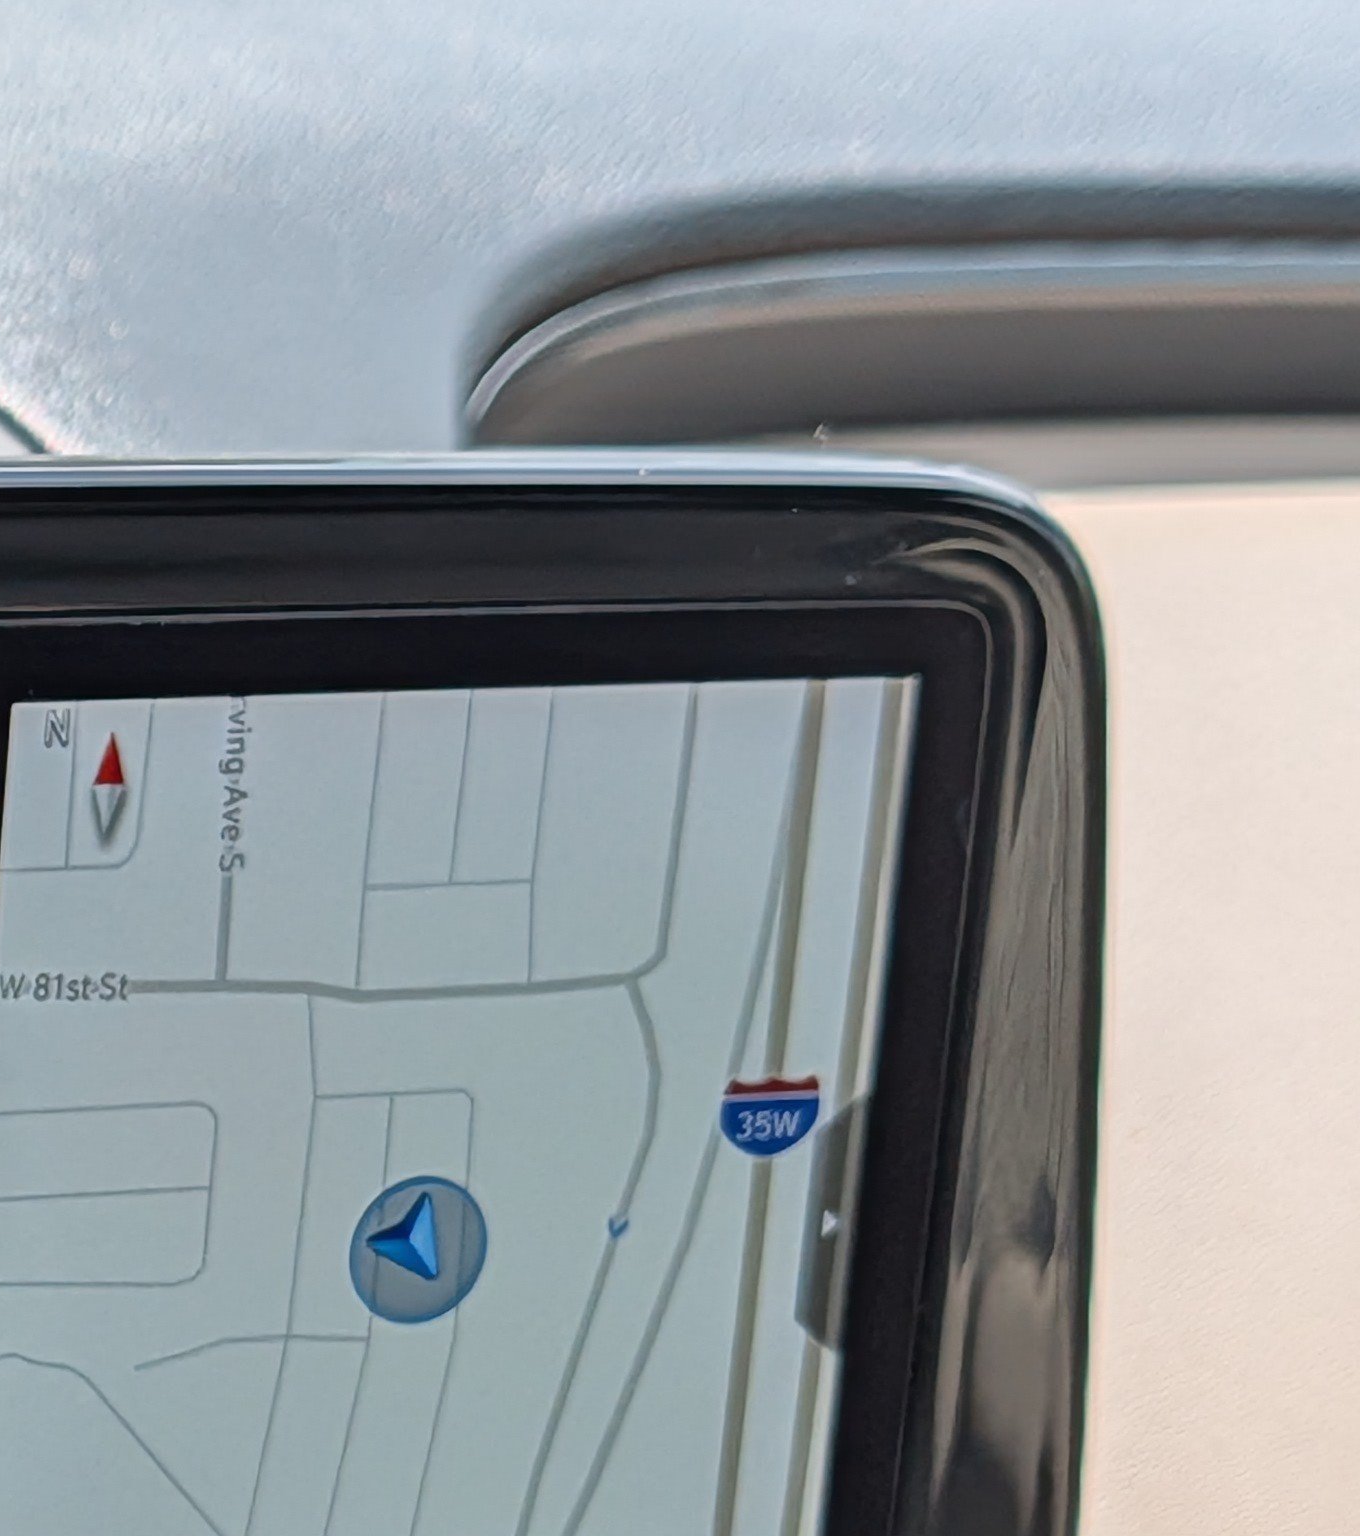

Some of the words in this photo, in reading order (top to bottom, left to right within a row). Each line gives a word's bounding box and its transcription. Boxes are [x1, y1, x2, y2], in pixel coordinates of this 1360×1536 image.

[43, 708, 71, 748] N
[221, 784, 248, 842] Ave
[218, 851, 246, 873] S
[0, 973, 26, 999] W
[33, 972, 91, 1001] 81st
[98, 971, 128, 1001] St
[736, 1110, 800, 1142] 35W
